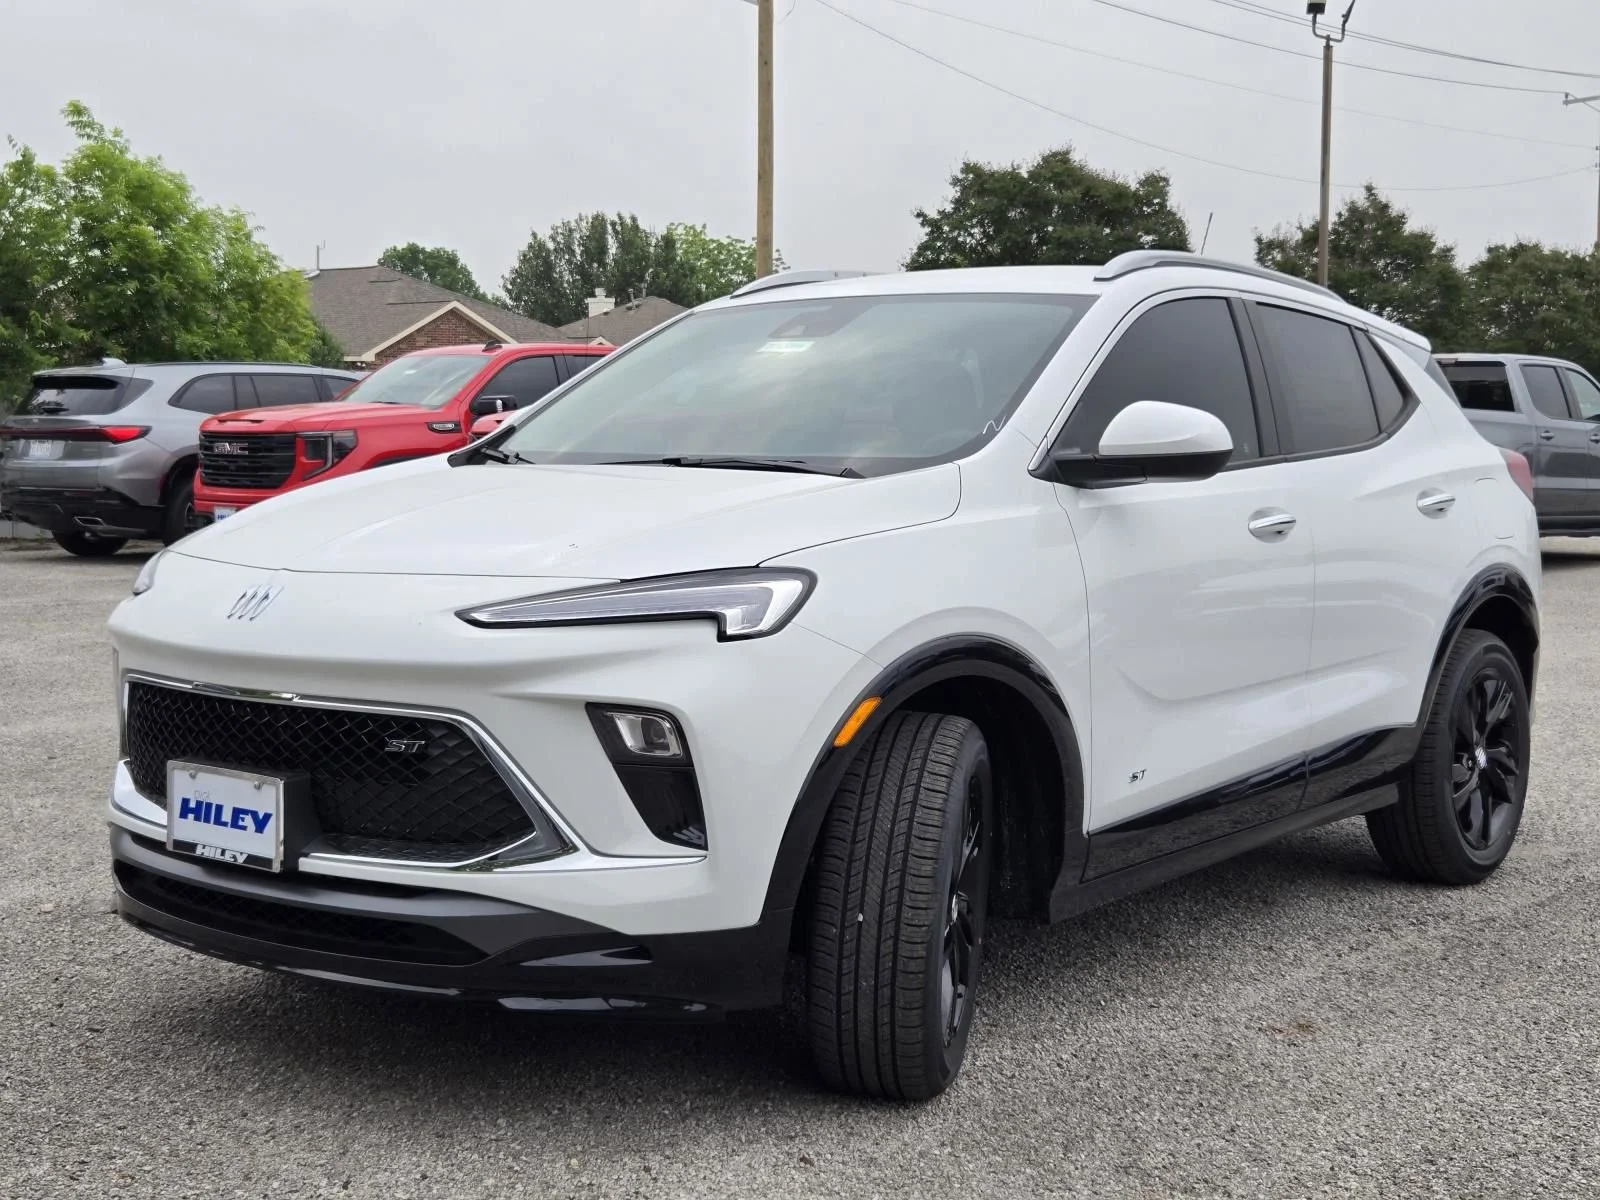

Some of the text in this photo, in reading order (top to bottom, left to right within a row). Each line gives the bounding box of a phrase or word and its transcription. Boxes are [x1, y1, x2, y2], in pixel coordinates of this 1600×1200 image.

[214, 442, 249, 455] GMC
[385, 739, 425, 752] ST
[1128, 769, 1147, 784] ST
[179, 797, 273, 834] HILEY
[195, 844, 248, 864] HILEY
